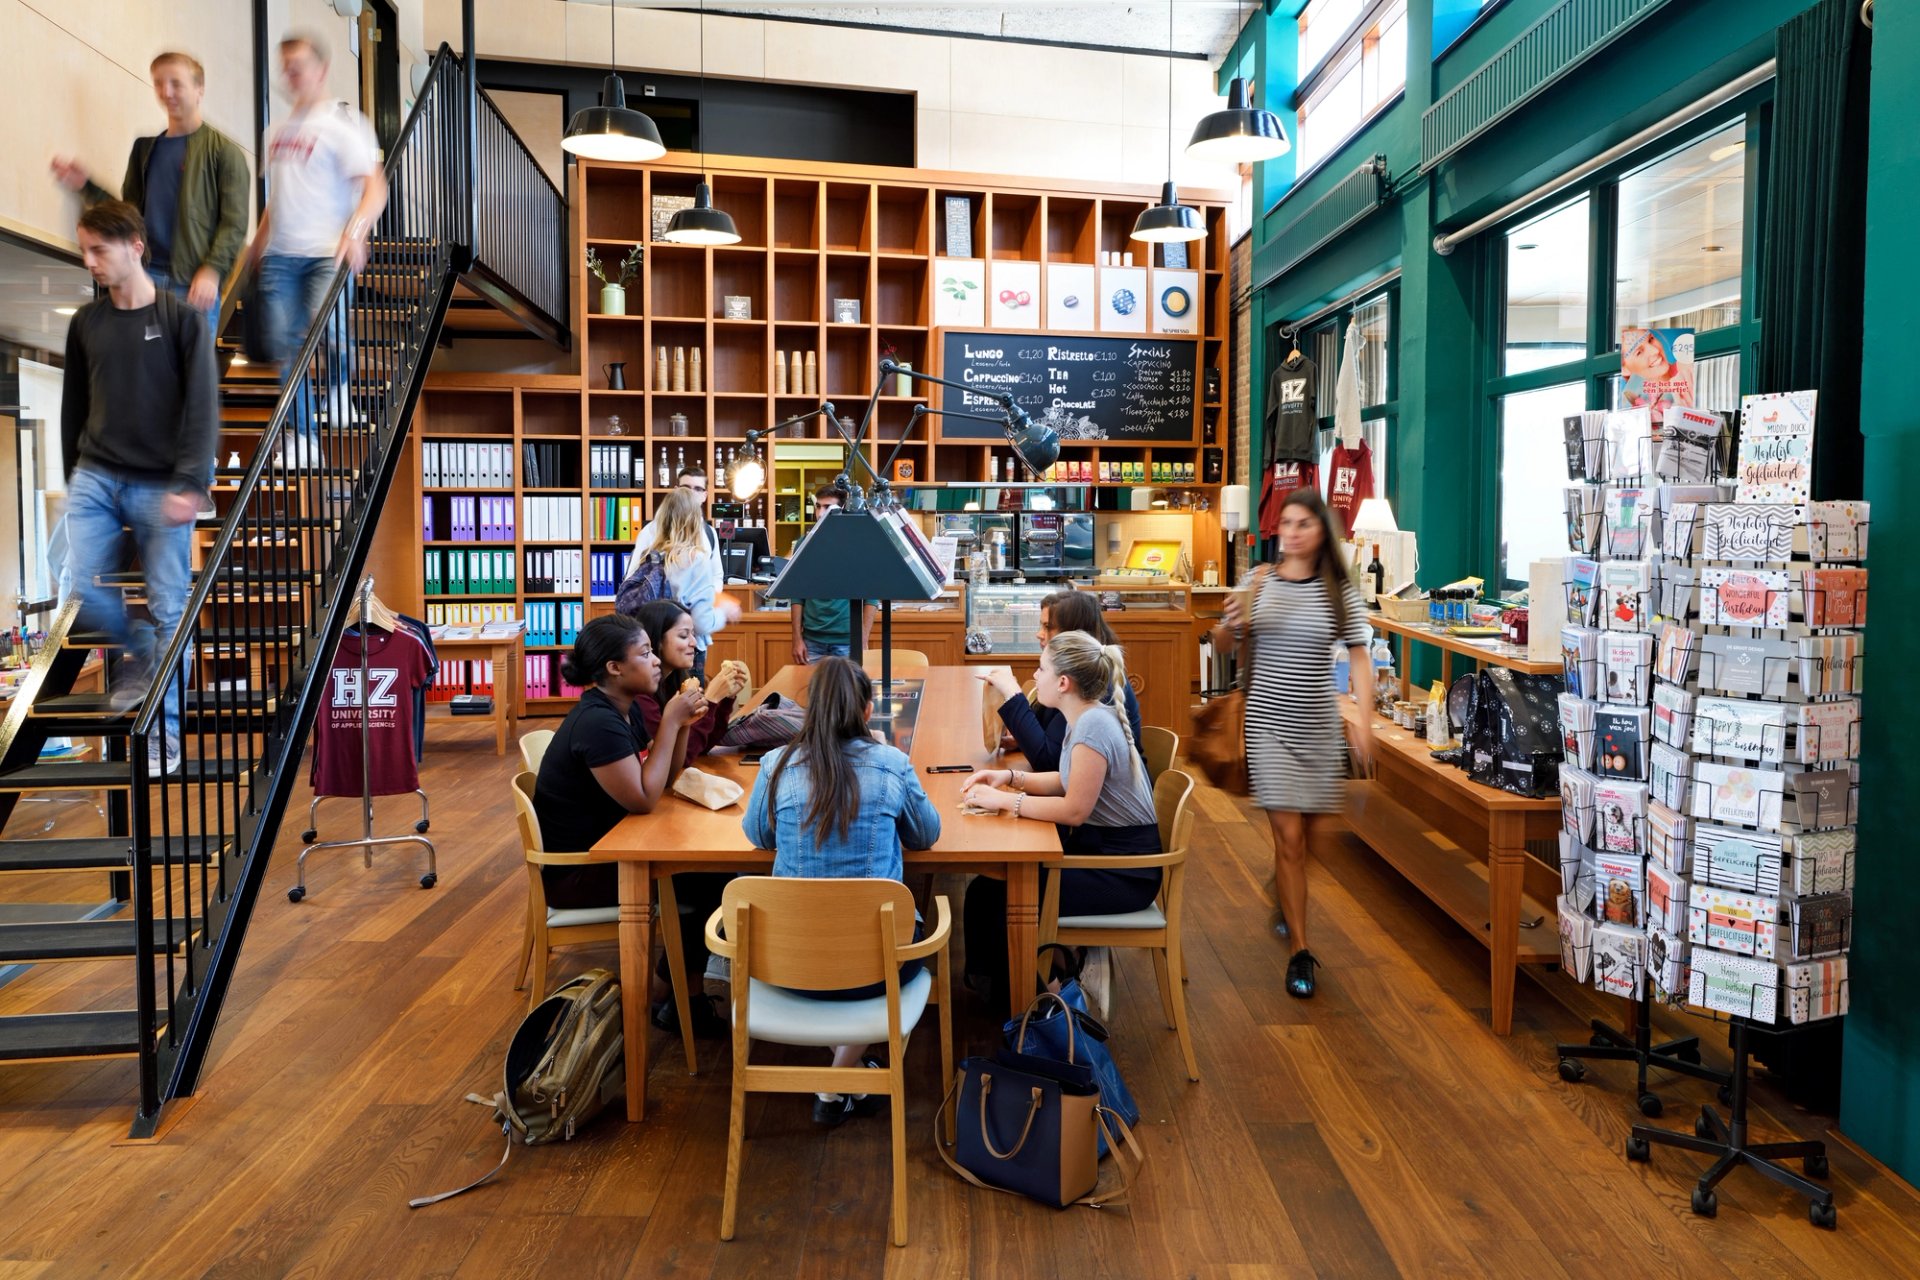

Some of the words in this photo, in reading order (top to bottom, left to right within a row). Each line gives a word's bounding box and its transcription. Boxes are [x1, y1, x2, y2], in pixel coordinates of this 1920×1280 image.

[1280, 378, 1307, 403] HZ
[1767, 424, 1788, 434] MUDDY
[1791, 423, 1807, 433] DUCK
[1274, 462, 1299, 479] HZ
[1334, 467, 1357, 495] HZ
[331, 668, 398, 708] HZ
[1710, 928, 1753, 944] GEFELICITEERD
